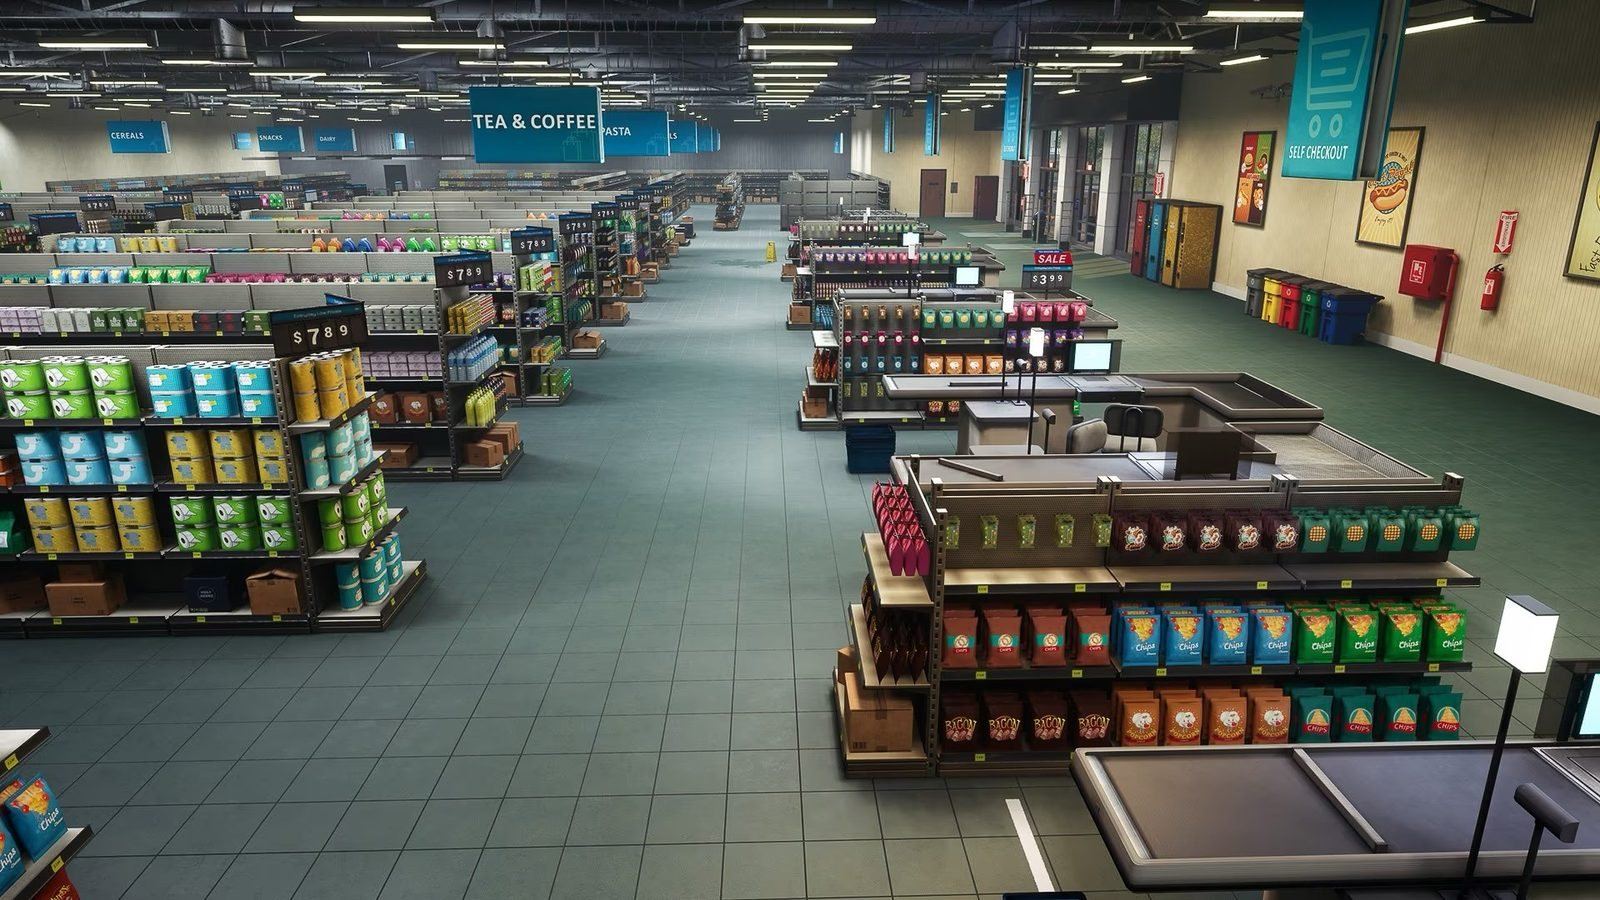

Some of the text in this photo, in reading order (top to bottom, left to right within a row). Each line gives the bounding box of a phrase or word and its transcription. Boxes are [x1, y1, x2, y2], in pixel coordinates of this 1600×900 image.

[473, 114, 596, 130] TEA & COFFEE
[111, 131, 145, 140] CEREALS
[1289, 145, 1349, 160] SELF CHECKOUT
[1037, 254, 1067, 263] SALE
[1136, 642, 1156, 651] Chips
[1179, 642, 1199, 651] Chips
[1224, 641, 1244, 650] Chips
[1268, 640, 1288, 650] Chips
[1311, 641, 1332, 650] Chips
[1355, 640, 1375, 649] Chips
[1399, 640, 1419, 649] Chips
[1442, 639, 1463, 648] Chips
[1307, 725, 1328, 733] CHIPS
[1350, 724, 1370, 733] CHIPS
[1394, 724, 1415, 732] CHIPS
[1437, 722, 1458, 731] CHIPS
[1126, 728, 1157, 740] POPCORN
[1169, 728, 1200, 740] POPCORN
[1214, 726, 1244, 739] POPCORN
[1258, 726, 1288, 738] POPCORN
[40, 808, 60, 831] Chips
